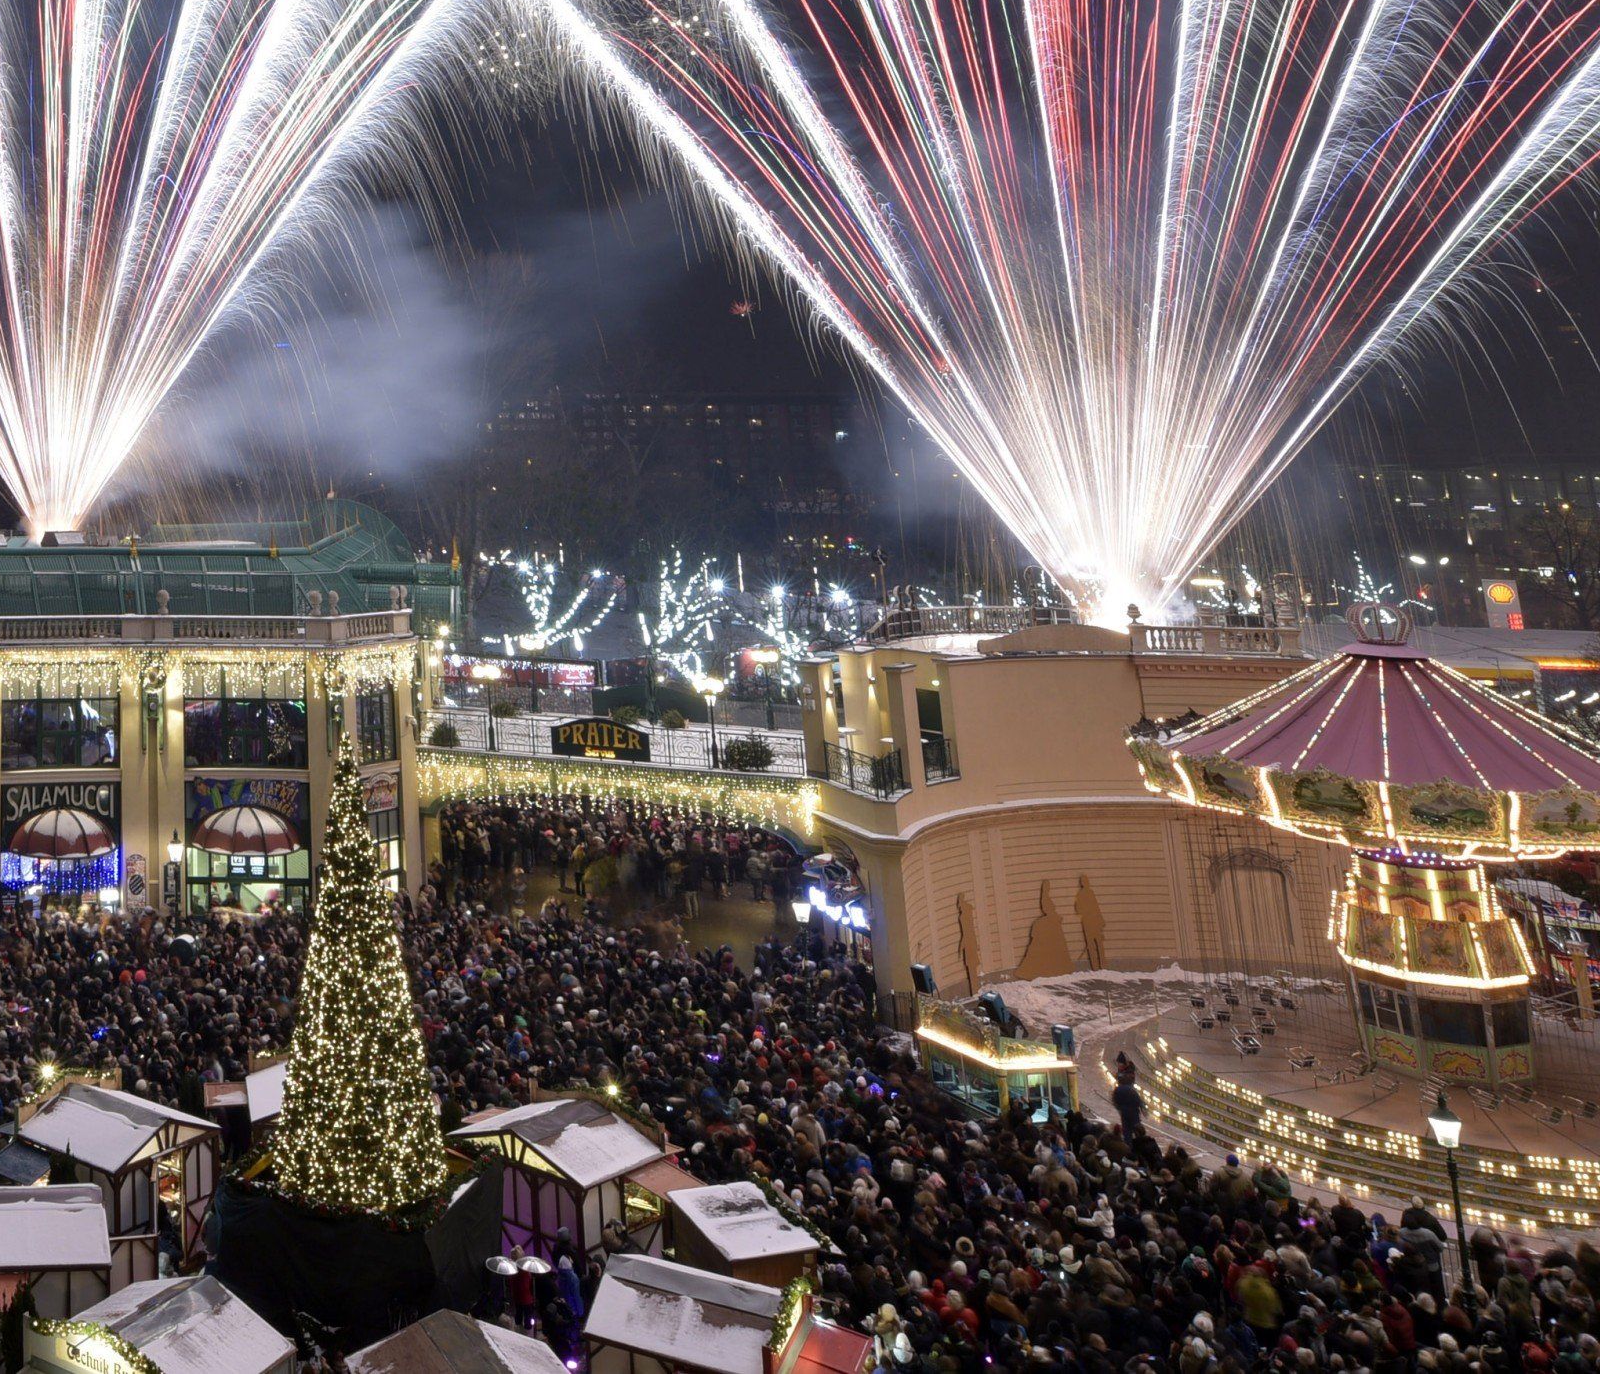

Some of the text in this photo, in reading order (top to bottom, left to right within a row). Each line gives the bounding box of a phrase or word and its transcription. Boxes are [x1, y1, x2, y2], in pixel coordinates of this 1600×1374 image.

[558, 722, 642, 750] PRATER
[6, 784, 115, 821] SALAMUCCI
[66, 1342, 110, 1374] Technik
